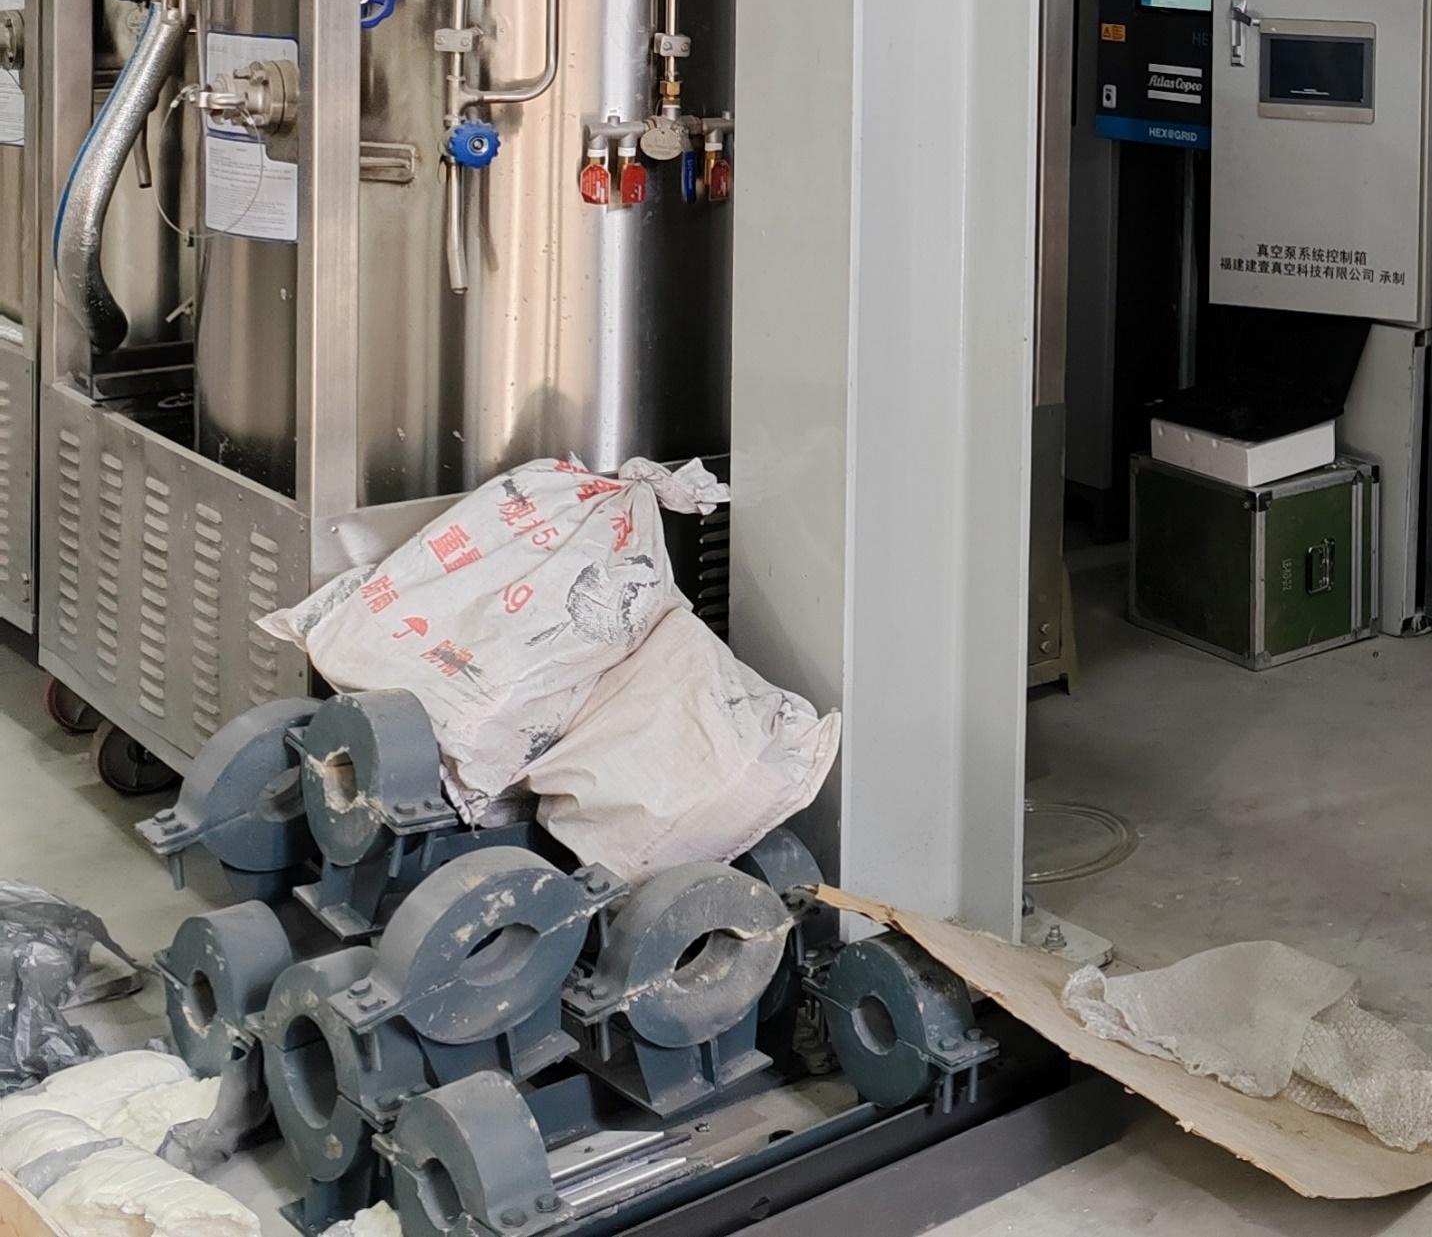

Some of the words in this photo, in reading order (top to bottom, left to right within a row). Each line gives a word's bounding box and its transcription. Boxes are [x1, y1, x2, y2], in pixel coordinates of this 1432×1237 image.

[1148, 75, 1175, 89] Atlas
[1175, 77, 1202, 92] Copco
[1256, 243, 1368, 266] 真空泵系统控制箱
[1379, 270, 1405, 285] 承制
[360, 574, 399, 614] 防雨
